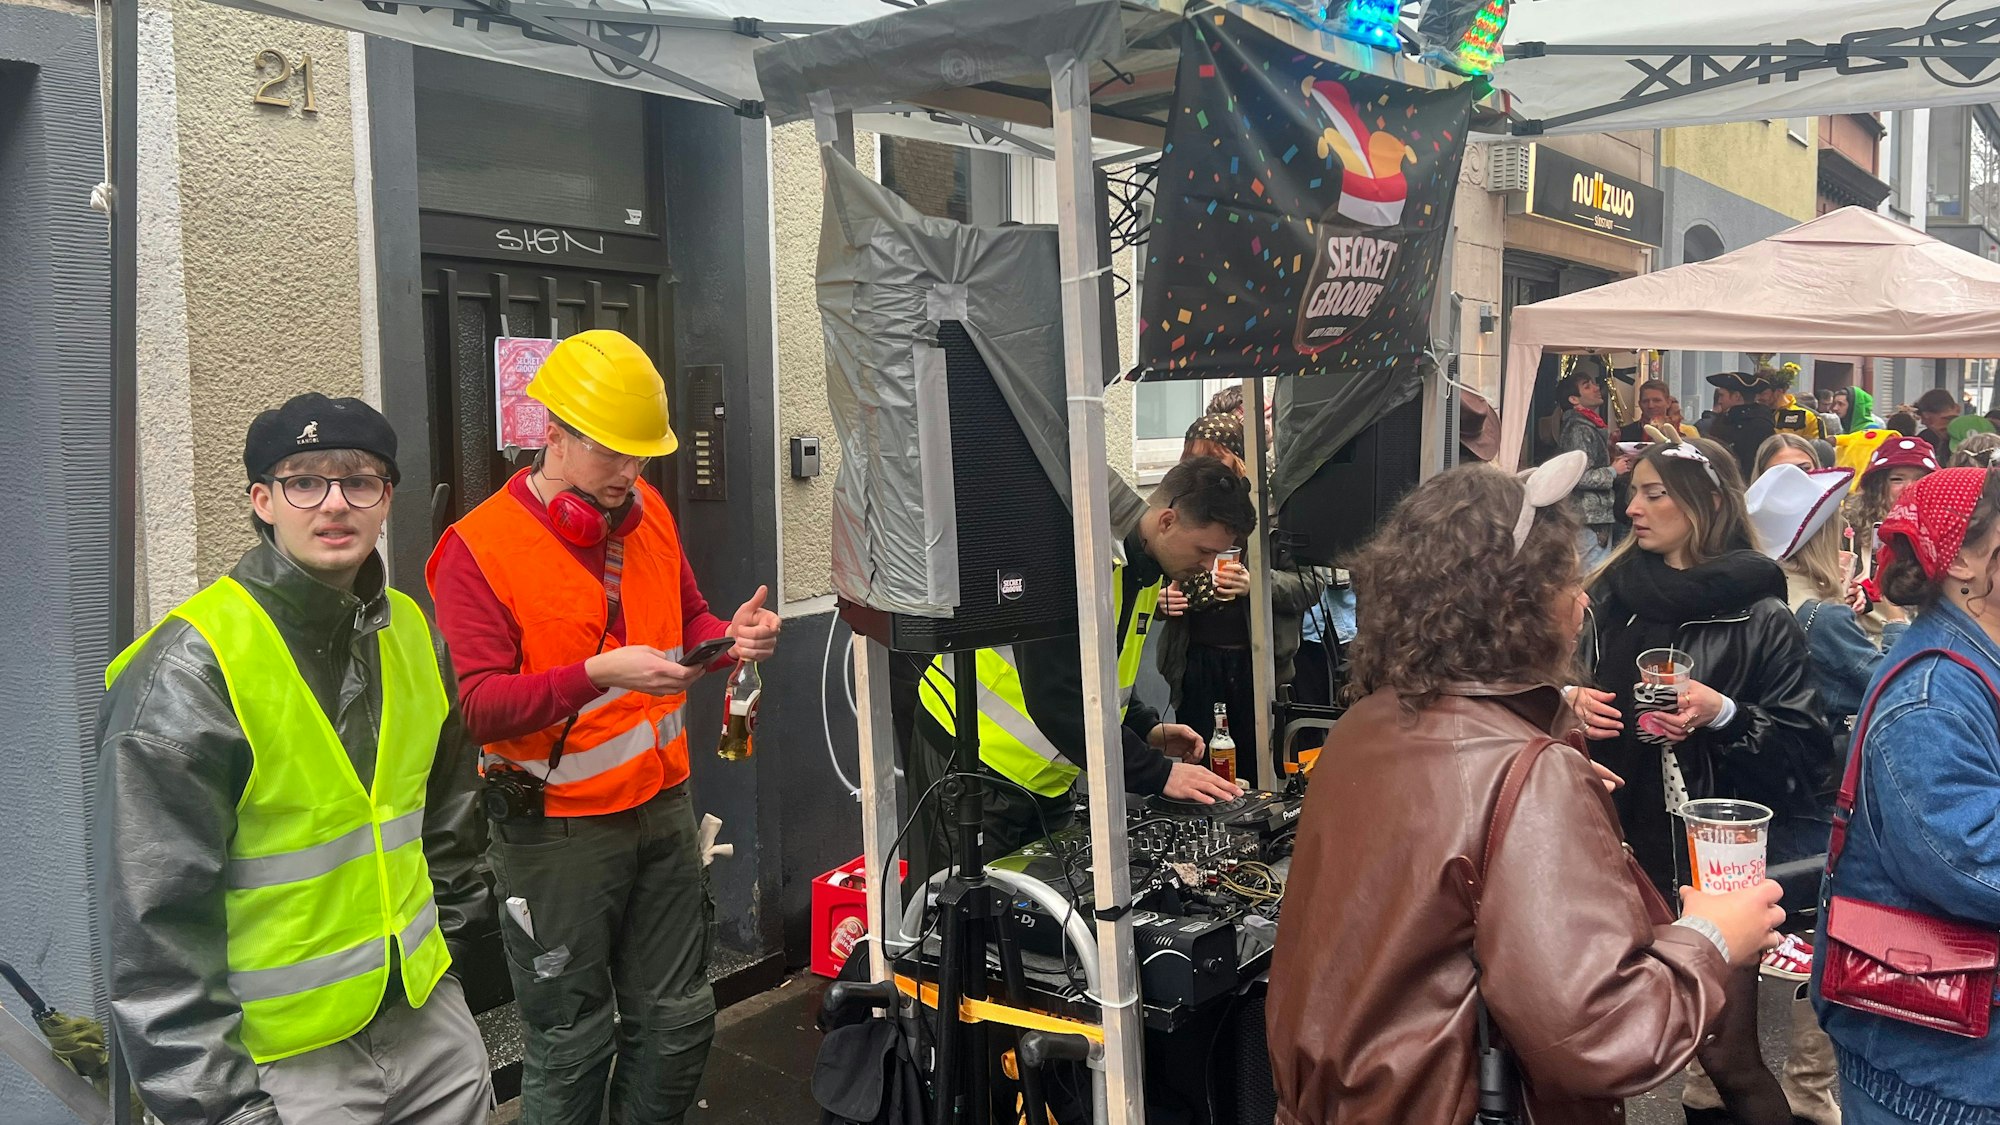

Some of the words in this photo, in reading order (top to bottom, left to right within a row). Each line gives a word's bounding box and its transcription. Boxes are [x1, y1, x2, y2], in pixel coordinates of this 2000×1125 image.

[254, 48, 318, 113] 21
[1572, 171, 1634, 219] nullzwo
[1327, 236, 1398, 280] SECRET
[1306, 281, 1385, 319] GROOVE
[516, 357, 541, 366] SECRET
[1003, 579, 1023, 587] SECRET
[1708, 859, 1748, 877] Mehr
[1712, 877, 1749, 891] ohne
